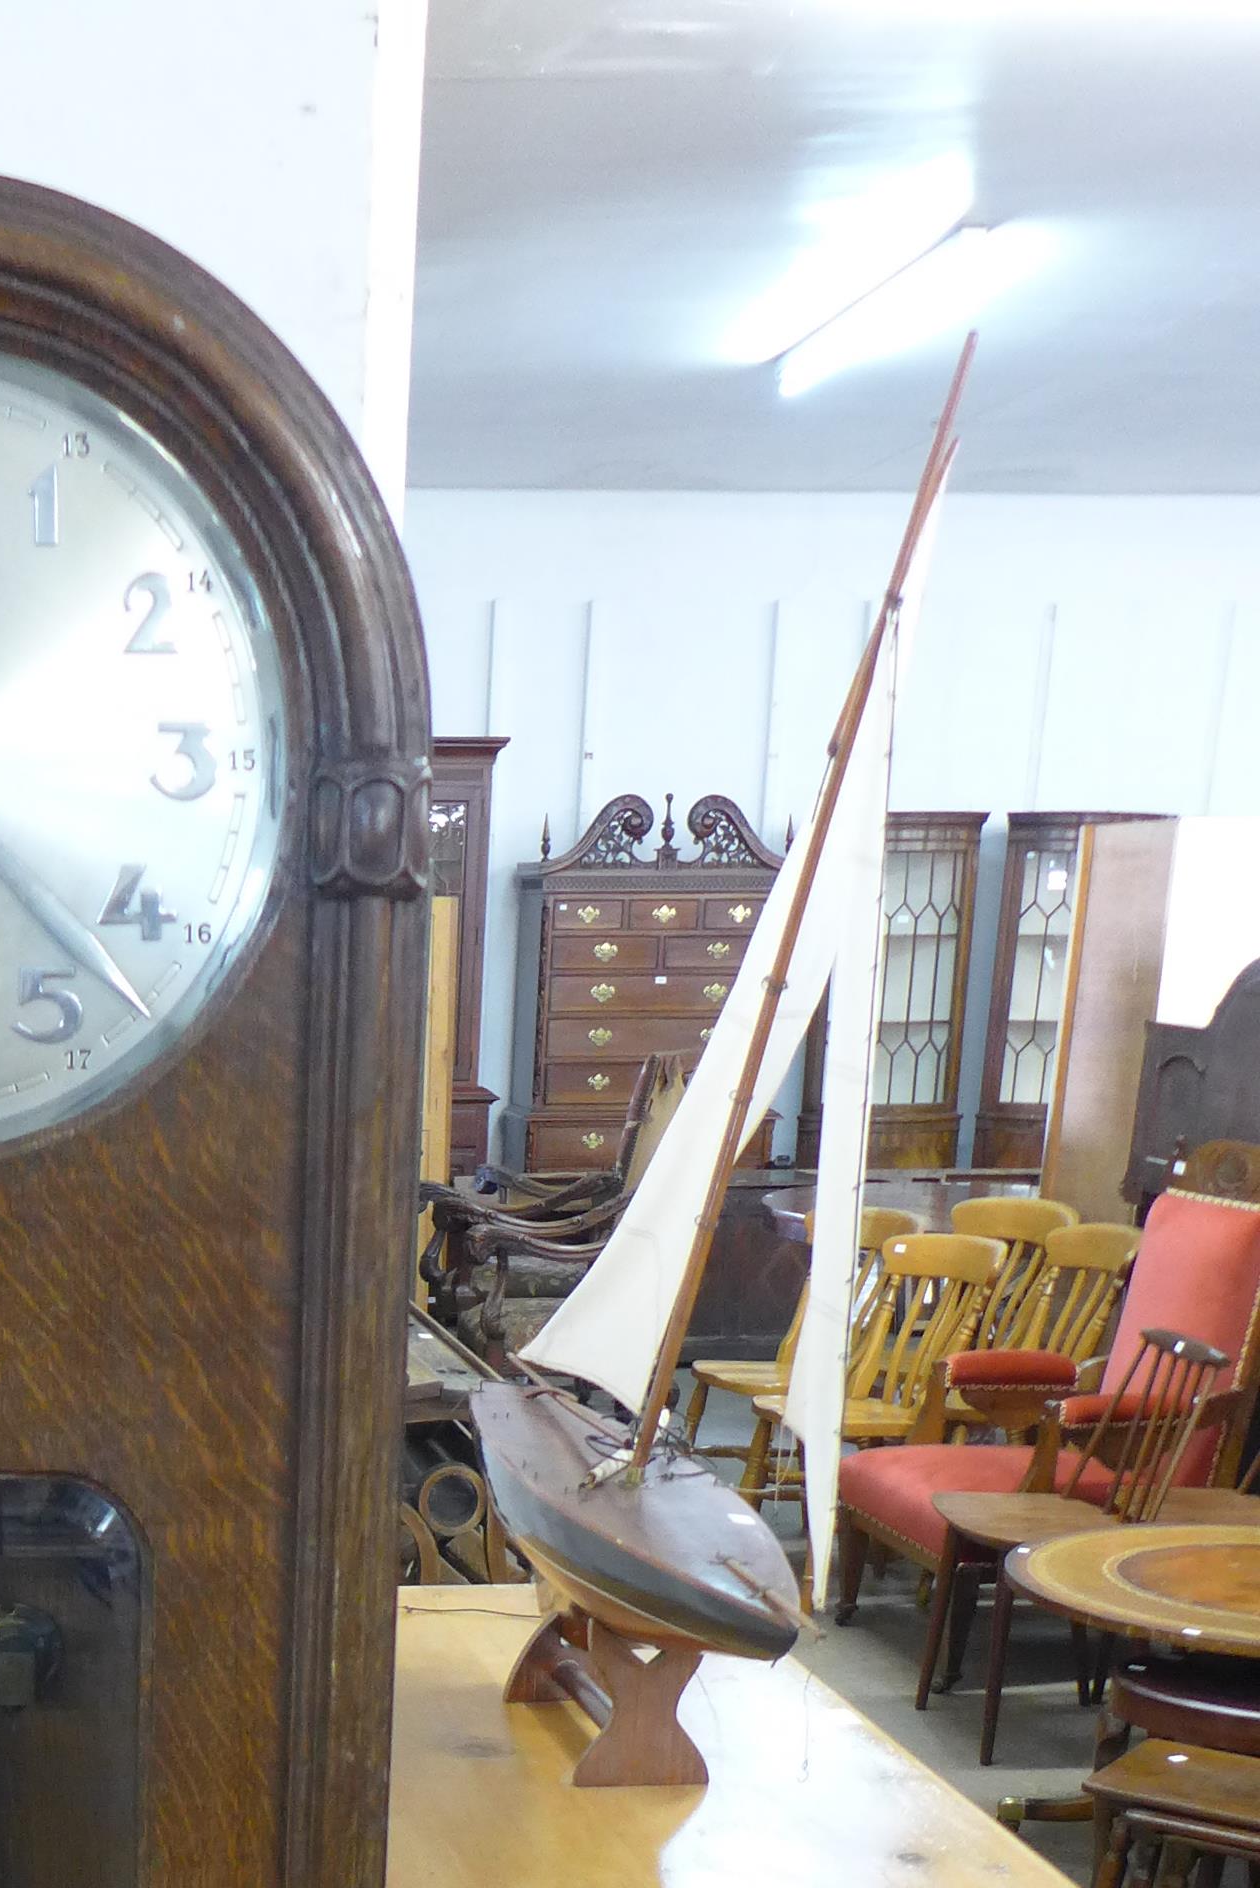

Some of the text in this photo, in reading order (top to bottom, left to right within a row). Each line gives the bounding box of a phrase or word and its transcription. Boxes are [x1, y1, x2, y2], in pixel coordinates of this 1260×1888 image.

[62, 431, 90, 458] 13
[28, 462, 59, 547] 1
[187, 569, 213, 593] 14
[123, 571, 178, 655] 2
[149, 721, 217, 802] 3
[228, 749, 256, 771] 15
[96, 863, 178, 942] 4
[183, 922, 212, 944] 16
[11, 965, 83, 1045] 5
[64, 1049, 92, 1071] 17
